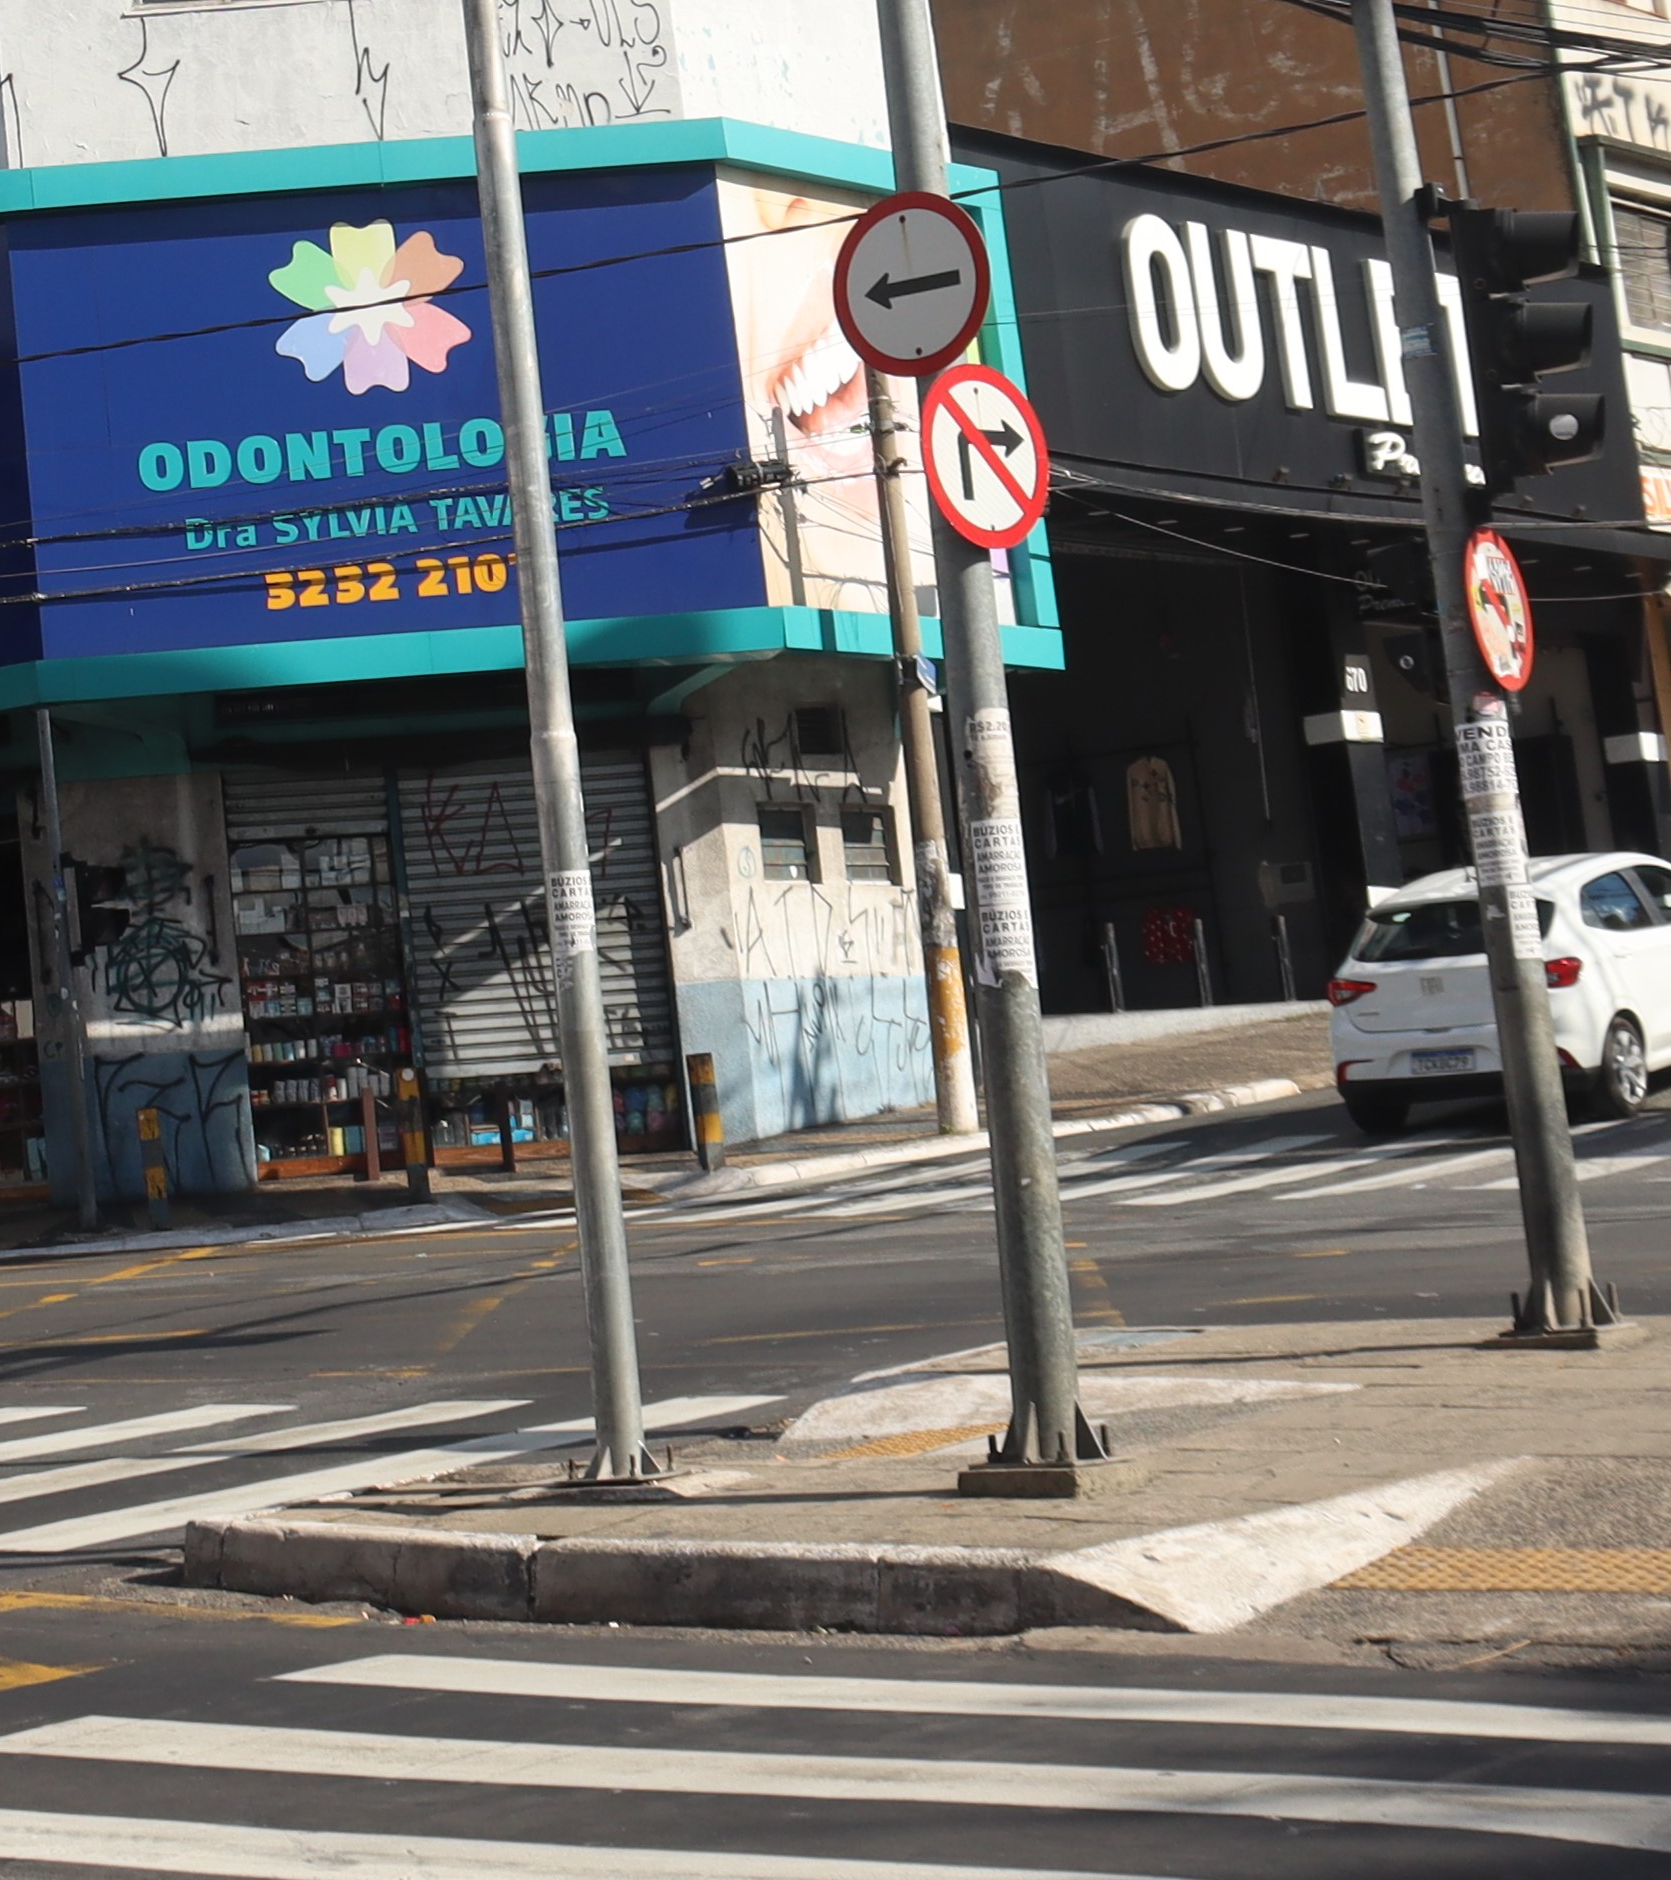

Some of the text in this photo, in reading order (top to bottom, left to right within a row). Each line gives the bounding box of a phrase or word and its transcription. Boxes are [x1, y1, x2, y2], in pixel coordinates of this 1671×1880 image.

[138, 409, 628, 492] ODONTOLOIA
[184, 517, 258, 551] Dra
[274, 498, 418, 545] SYLVIA
[264, 553, 517, 611] 3232 210
